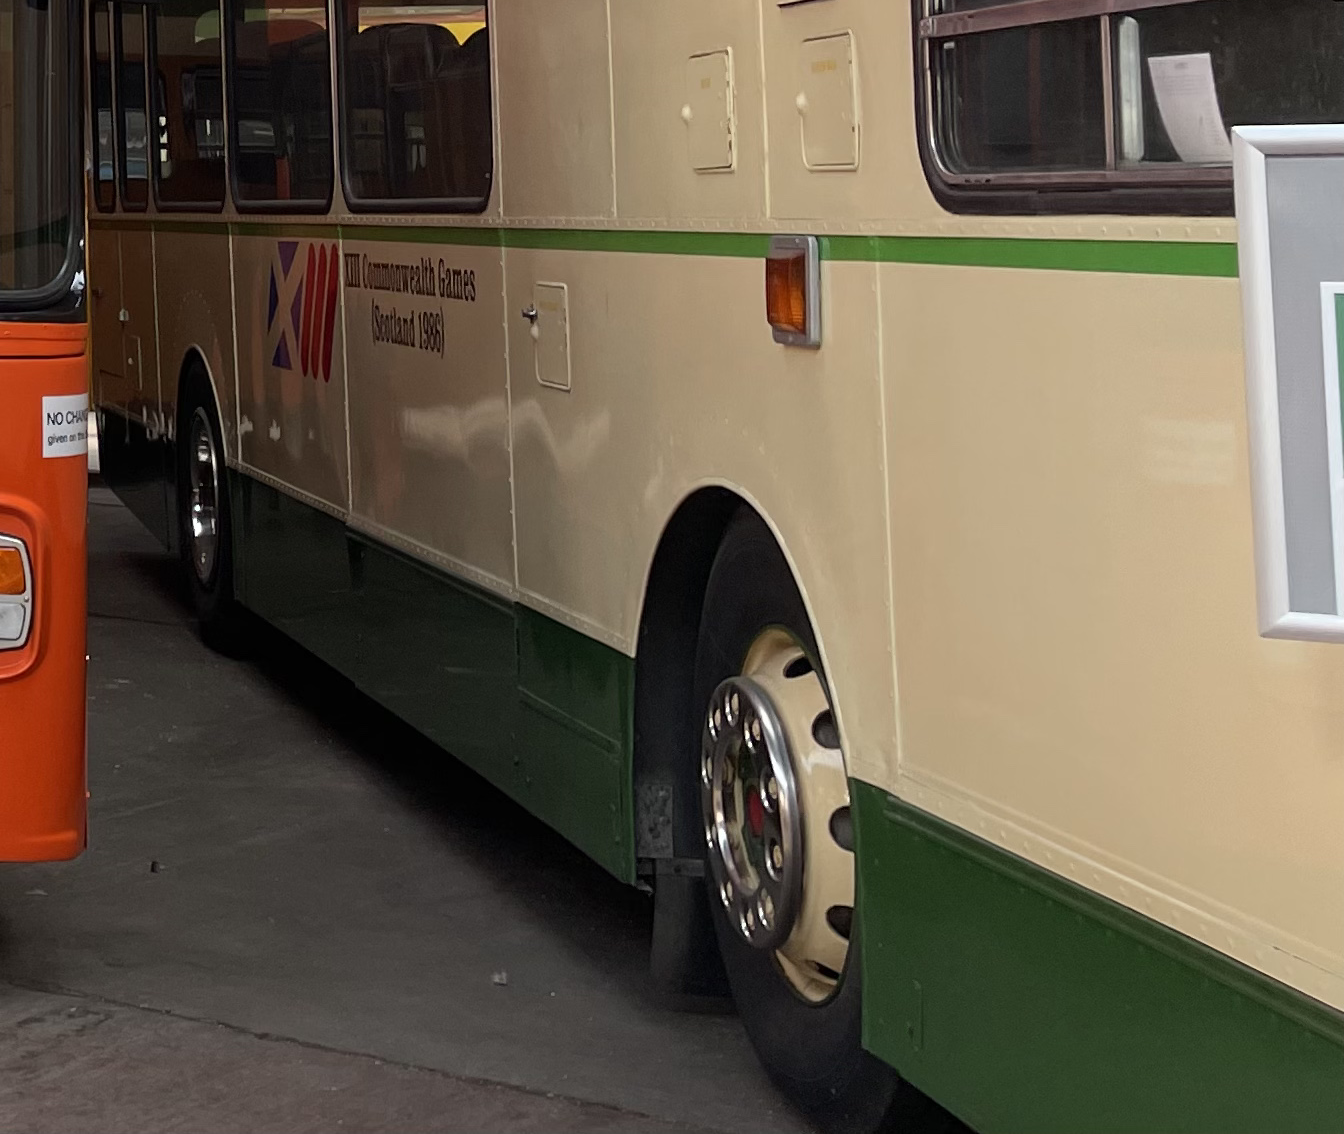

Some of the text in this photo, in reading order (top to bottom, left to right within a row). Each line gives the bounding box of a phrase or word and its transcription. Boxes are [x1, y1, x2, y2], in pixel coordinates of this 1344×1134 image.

[344, 253, 477, 302] XIII Commonwealth Games
[371, 297, 446, 360] (Scotland 1986)
[46, 411, 64, 426] NO
[47, 433, 68, 447] given
